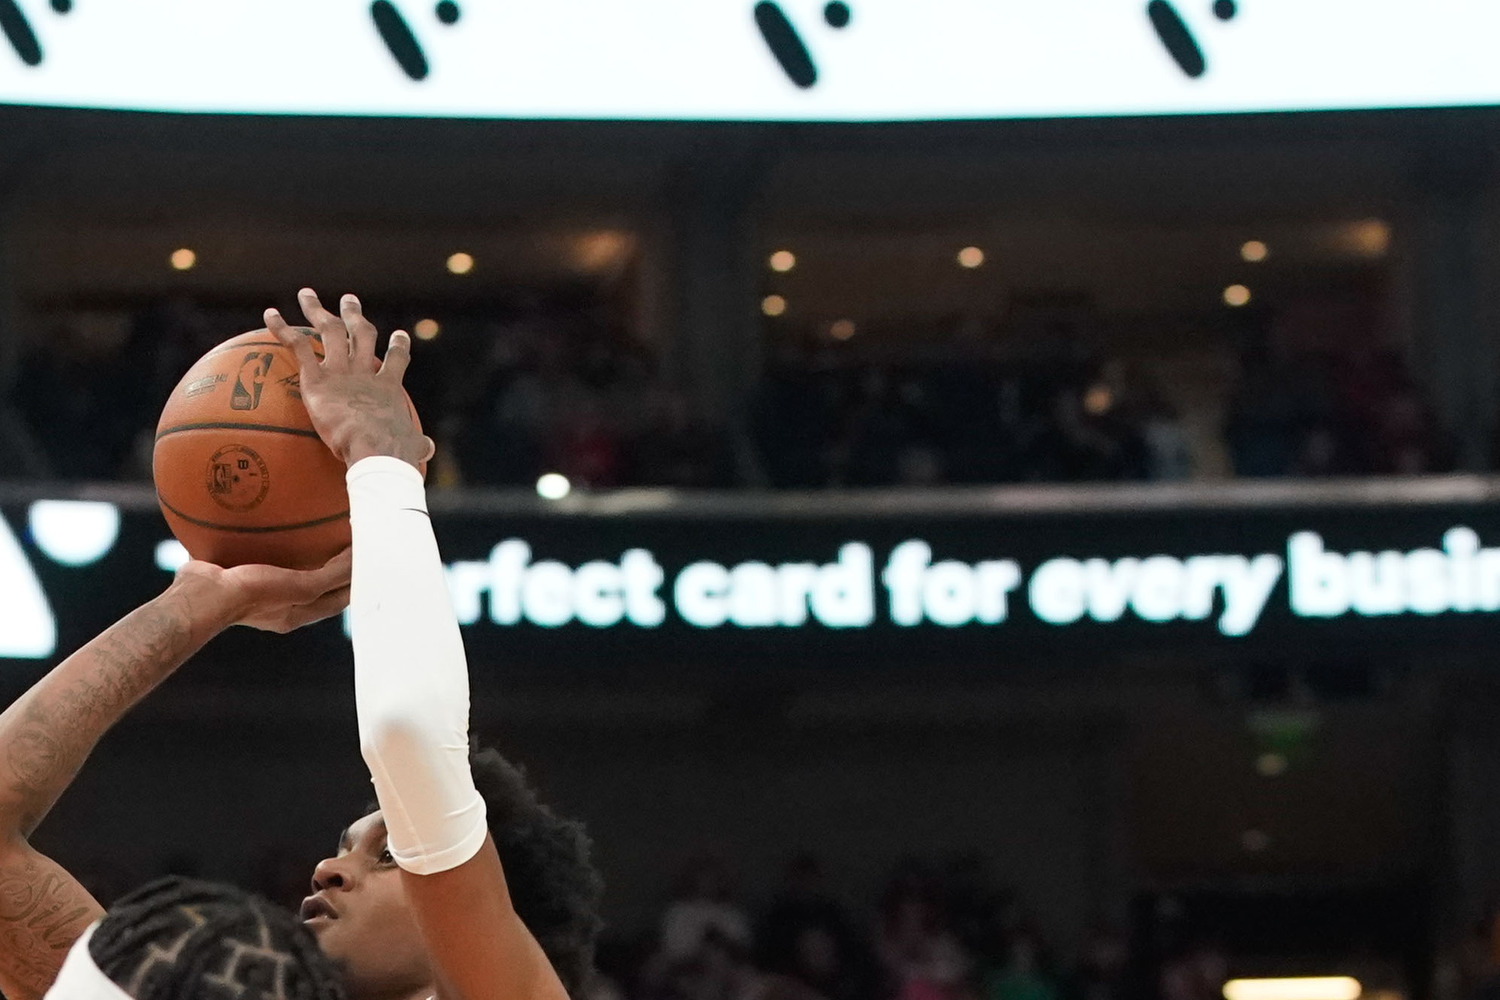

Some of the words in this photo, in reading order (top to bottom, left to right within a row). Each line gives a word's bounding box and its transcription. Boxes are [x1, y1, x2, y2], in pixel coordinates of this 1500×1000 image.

[674, 542, 875, 628] card
[882, 540, 1021, 627] for
[1029, 553, 1283, 637] every
